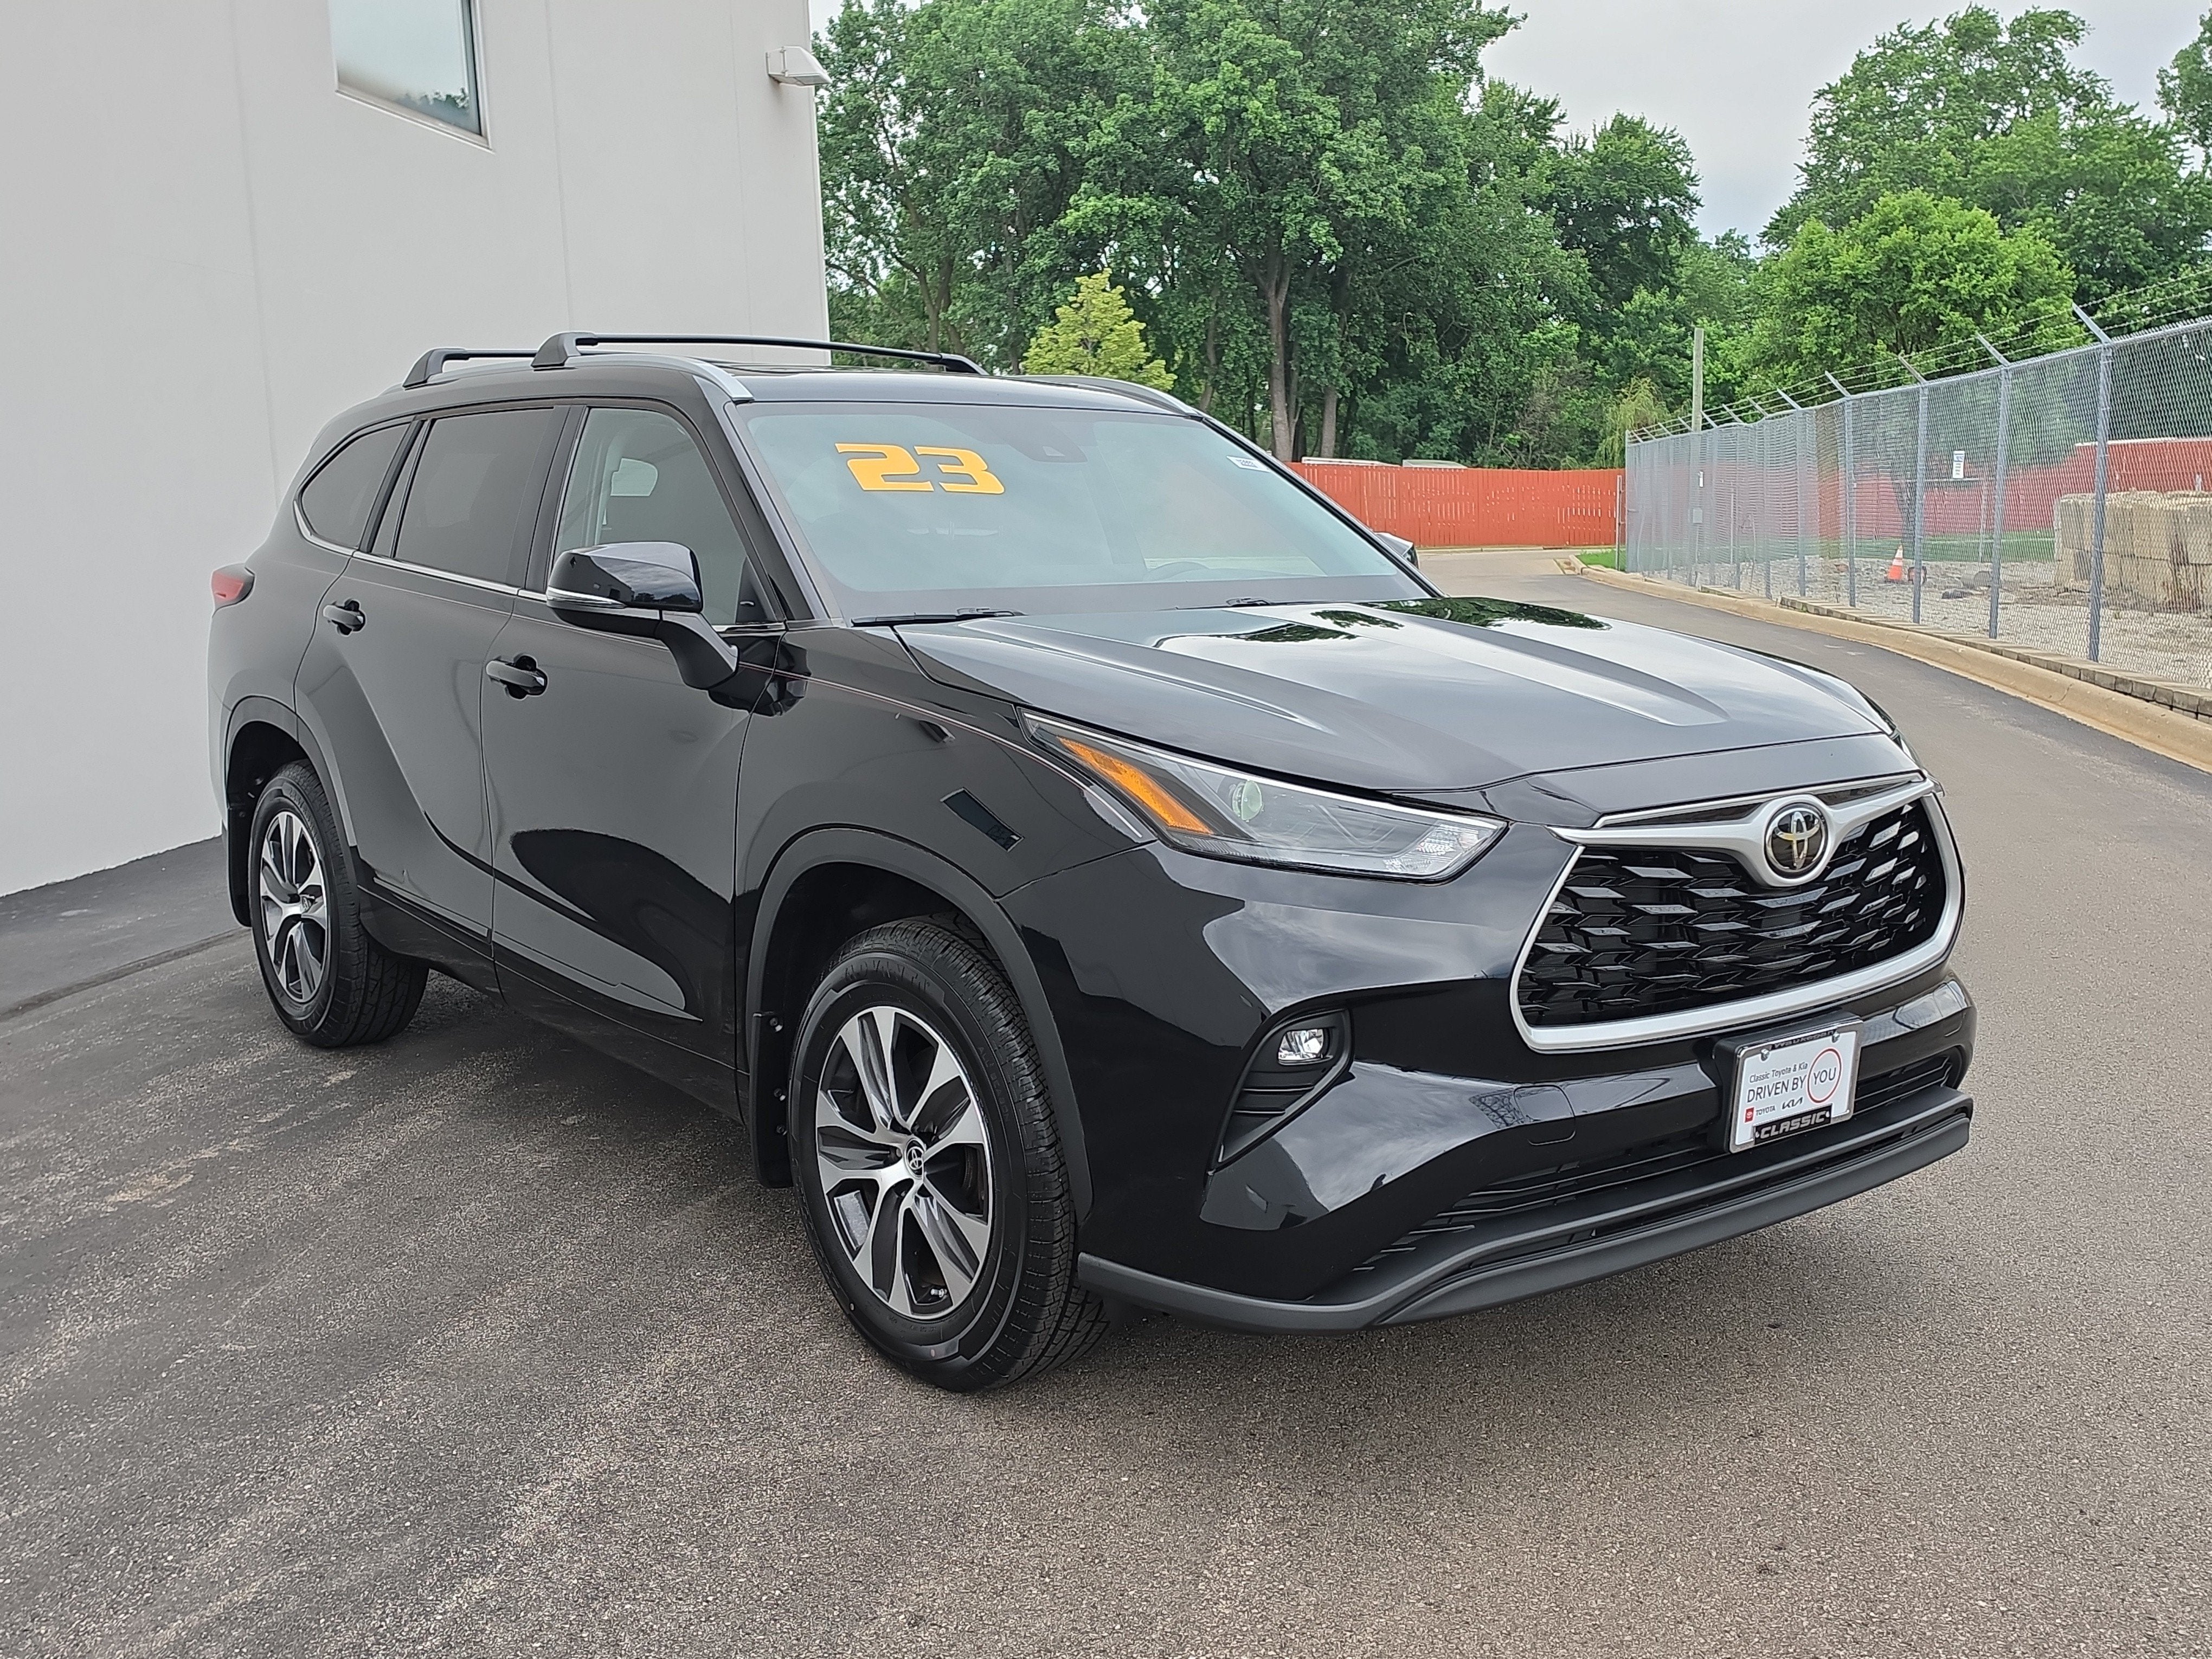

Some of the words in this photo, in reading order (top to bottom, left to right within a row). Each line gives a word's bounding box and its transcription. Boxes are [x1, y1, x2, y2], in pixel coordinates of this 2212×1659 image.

[834, 442, 1006, 496] 23
[1747, 1081, 1789, 1103] DRIVEN
[1791, 1074, 1807, 1091] BY
[1813, 1067, 1837, 1085] YOU
[1750, 1072, 1770, 1083] Classic
[1771, 1066, 1792, 1078] Toyota
[1792, 1064, 1797, 1072] &
[1798, 1062, 1808, 1071] Kia
[1756, 1106, 1776, 1116] TOYOTA
[1760, 1111, 1827, 1139] CLASSIC
